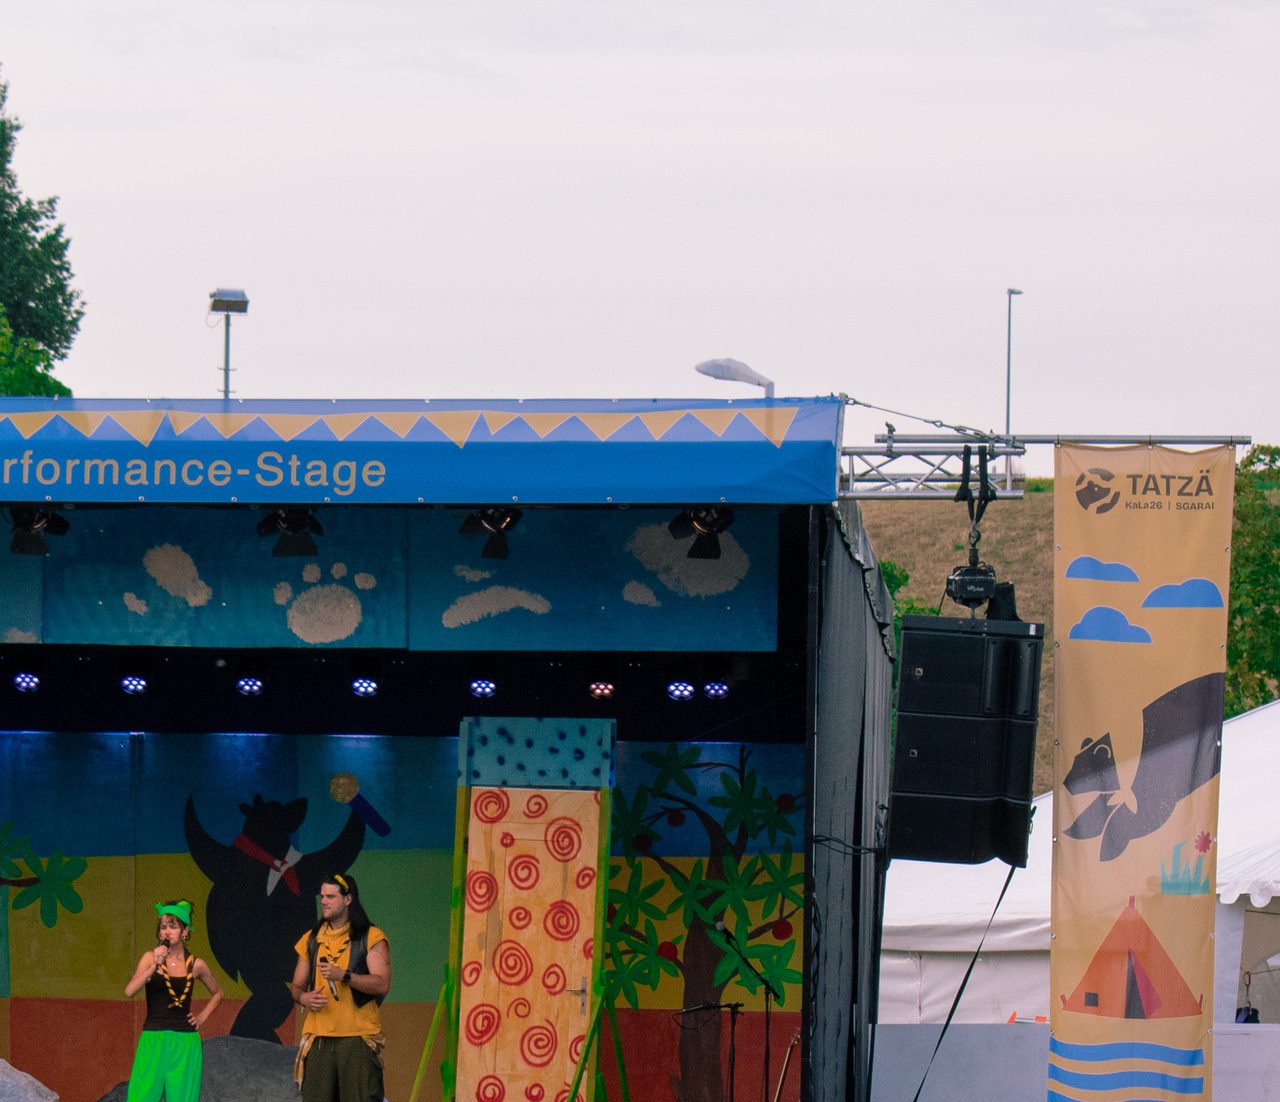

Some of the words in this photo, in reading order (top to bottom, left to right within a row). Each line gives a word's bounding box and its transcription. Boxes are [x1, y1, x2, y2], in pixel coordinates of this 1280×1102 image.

[1125, 468, 1214, 497] TATZÄ
[1124, 501, 1163, 510] KaLa26
[1175, 501, 1215, 511] SGARAI
